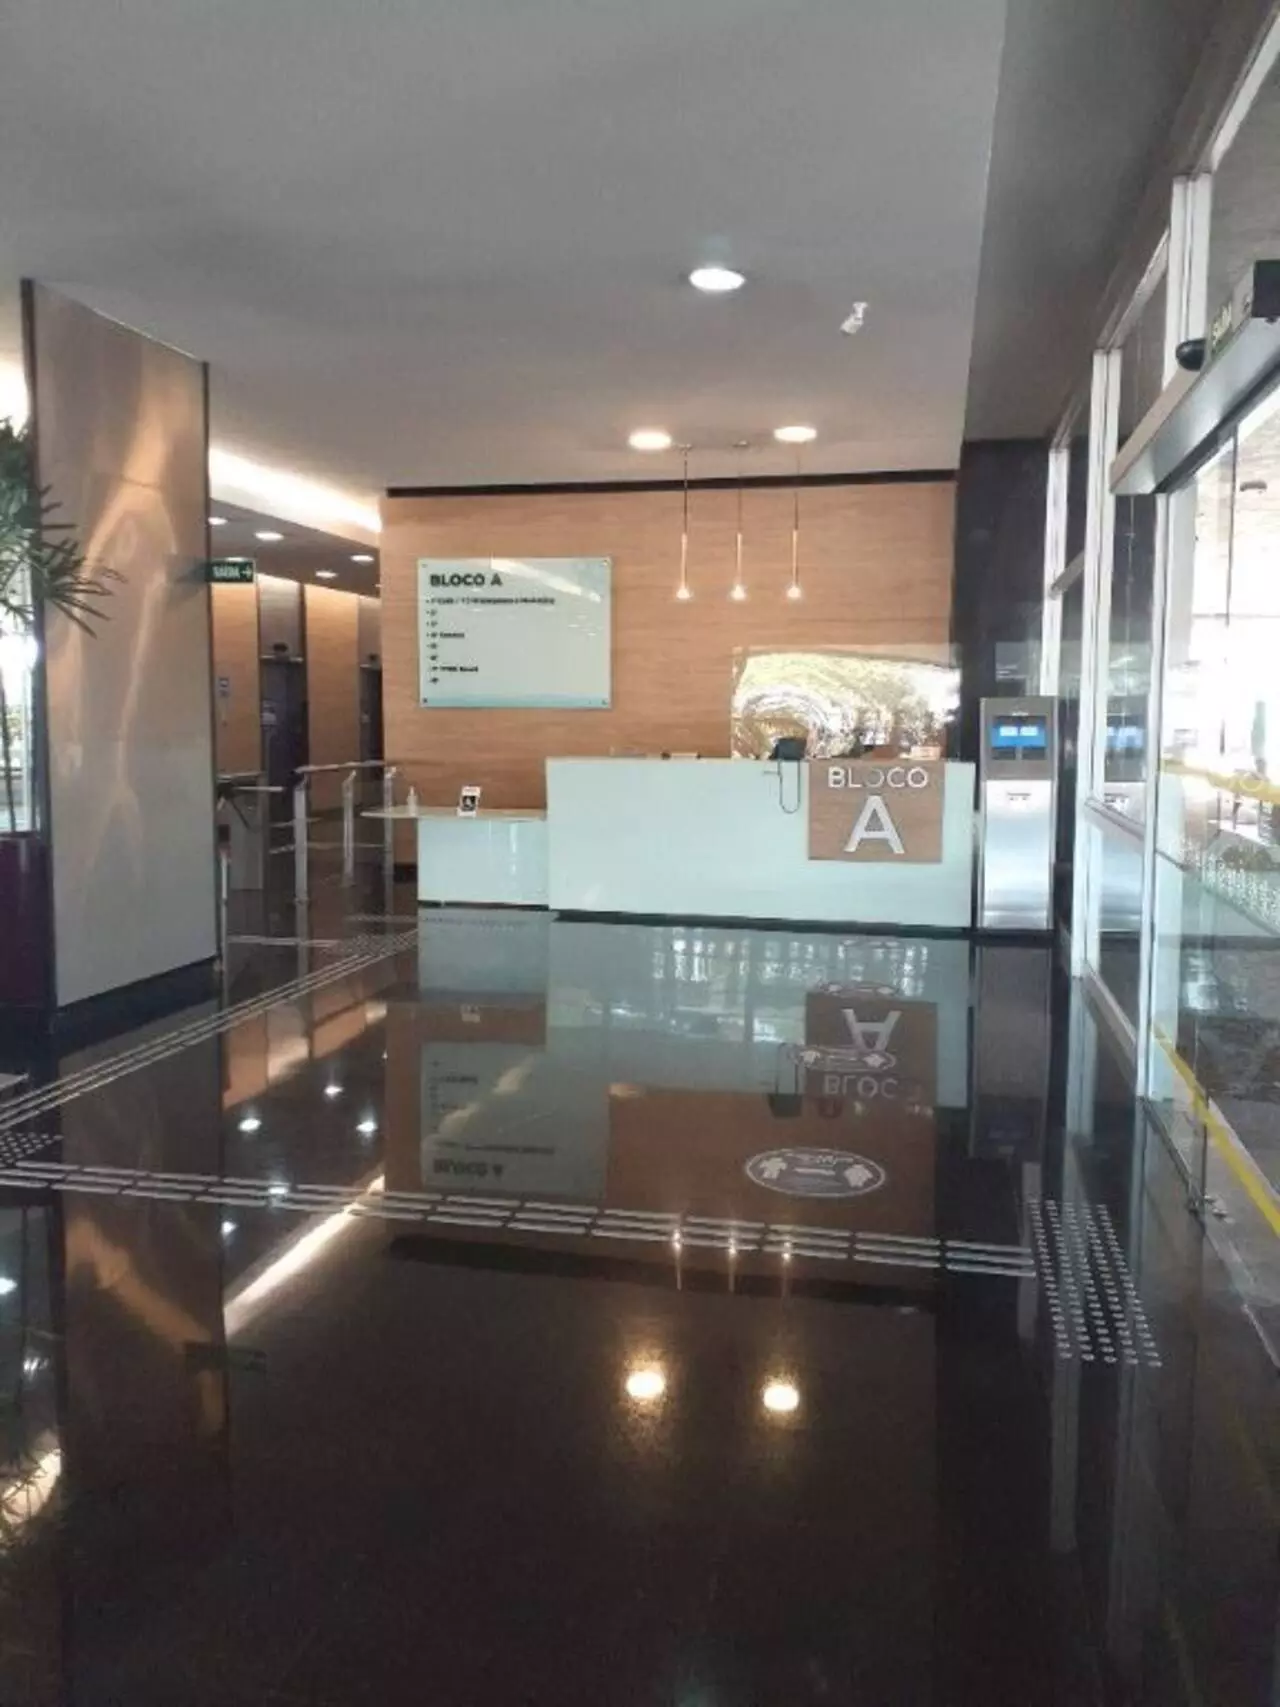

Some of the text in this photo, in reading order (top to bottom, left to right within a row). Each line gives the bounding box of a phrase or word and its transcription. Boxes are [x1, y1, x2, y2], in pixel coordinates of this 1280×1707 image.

[430, 572, 503, 587] BLOCO A
[828, 766, 928, 789] BLOCO
[843, 795, 905, 854] A
